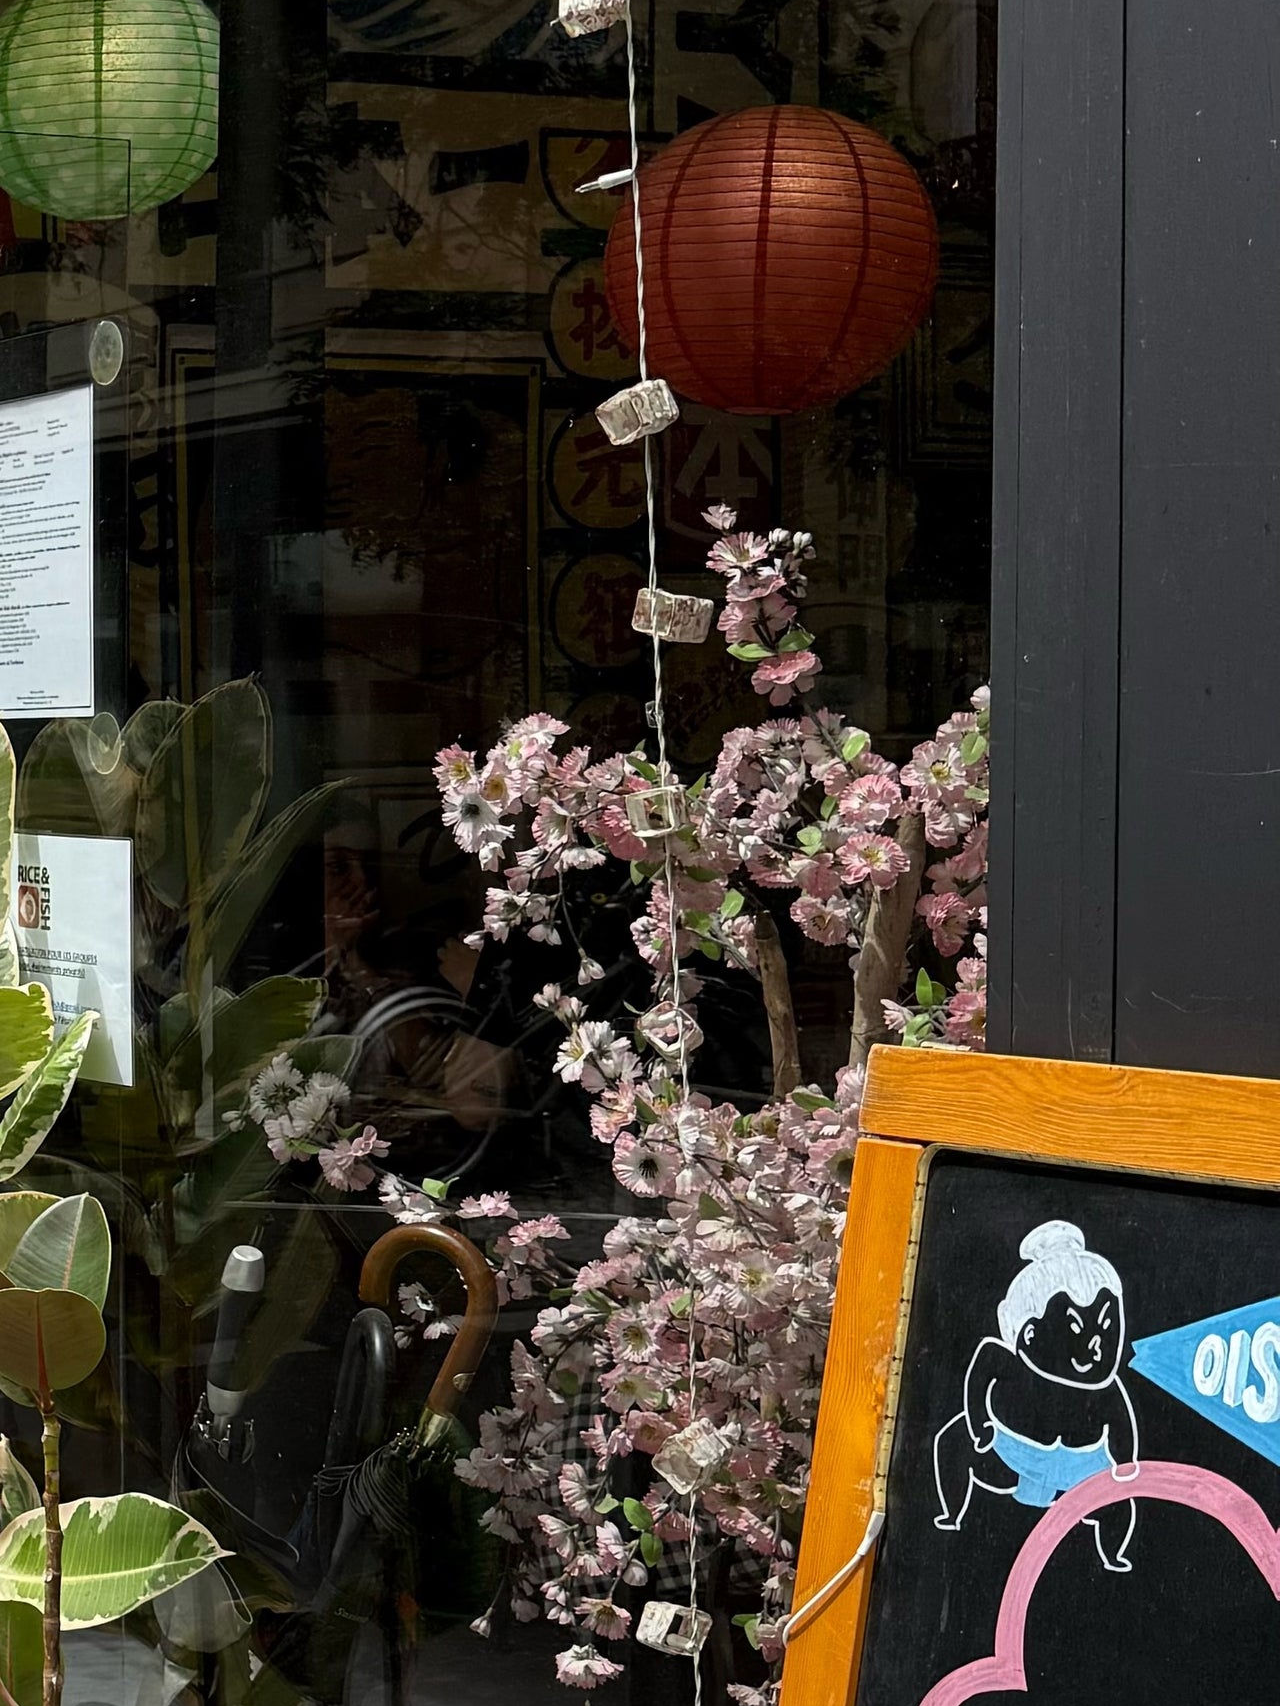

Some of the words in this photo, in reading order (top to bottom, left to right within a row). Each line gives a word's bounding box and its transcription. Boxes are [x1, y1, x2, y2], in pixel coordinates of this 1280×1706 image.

[18, 865, 40, 884] RICE
[41, 867, 50, 884] &
[40, 887, 51, 931] FISH
